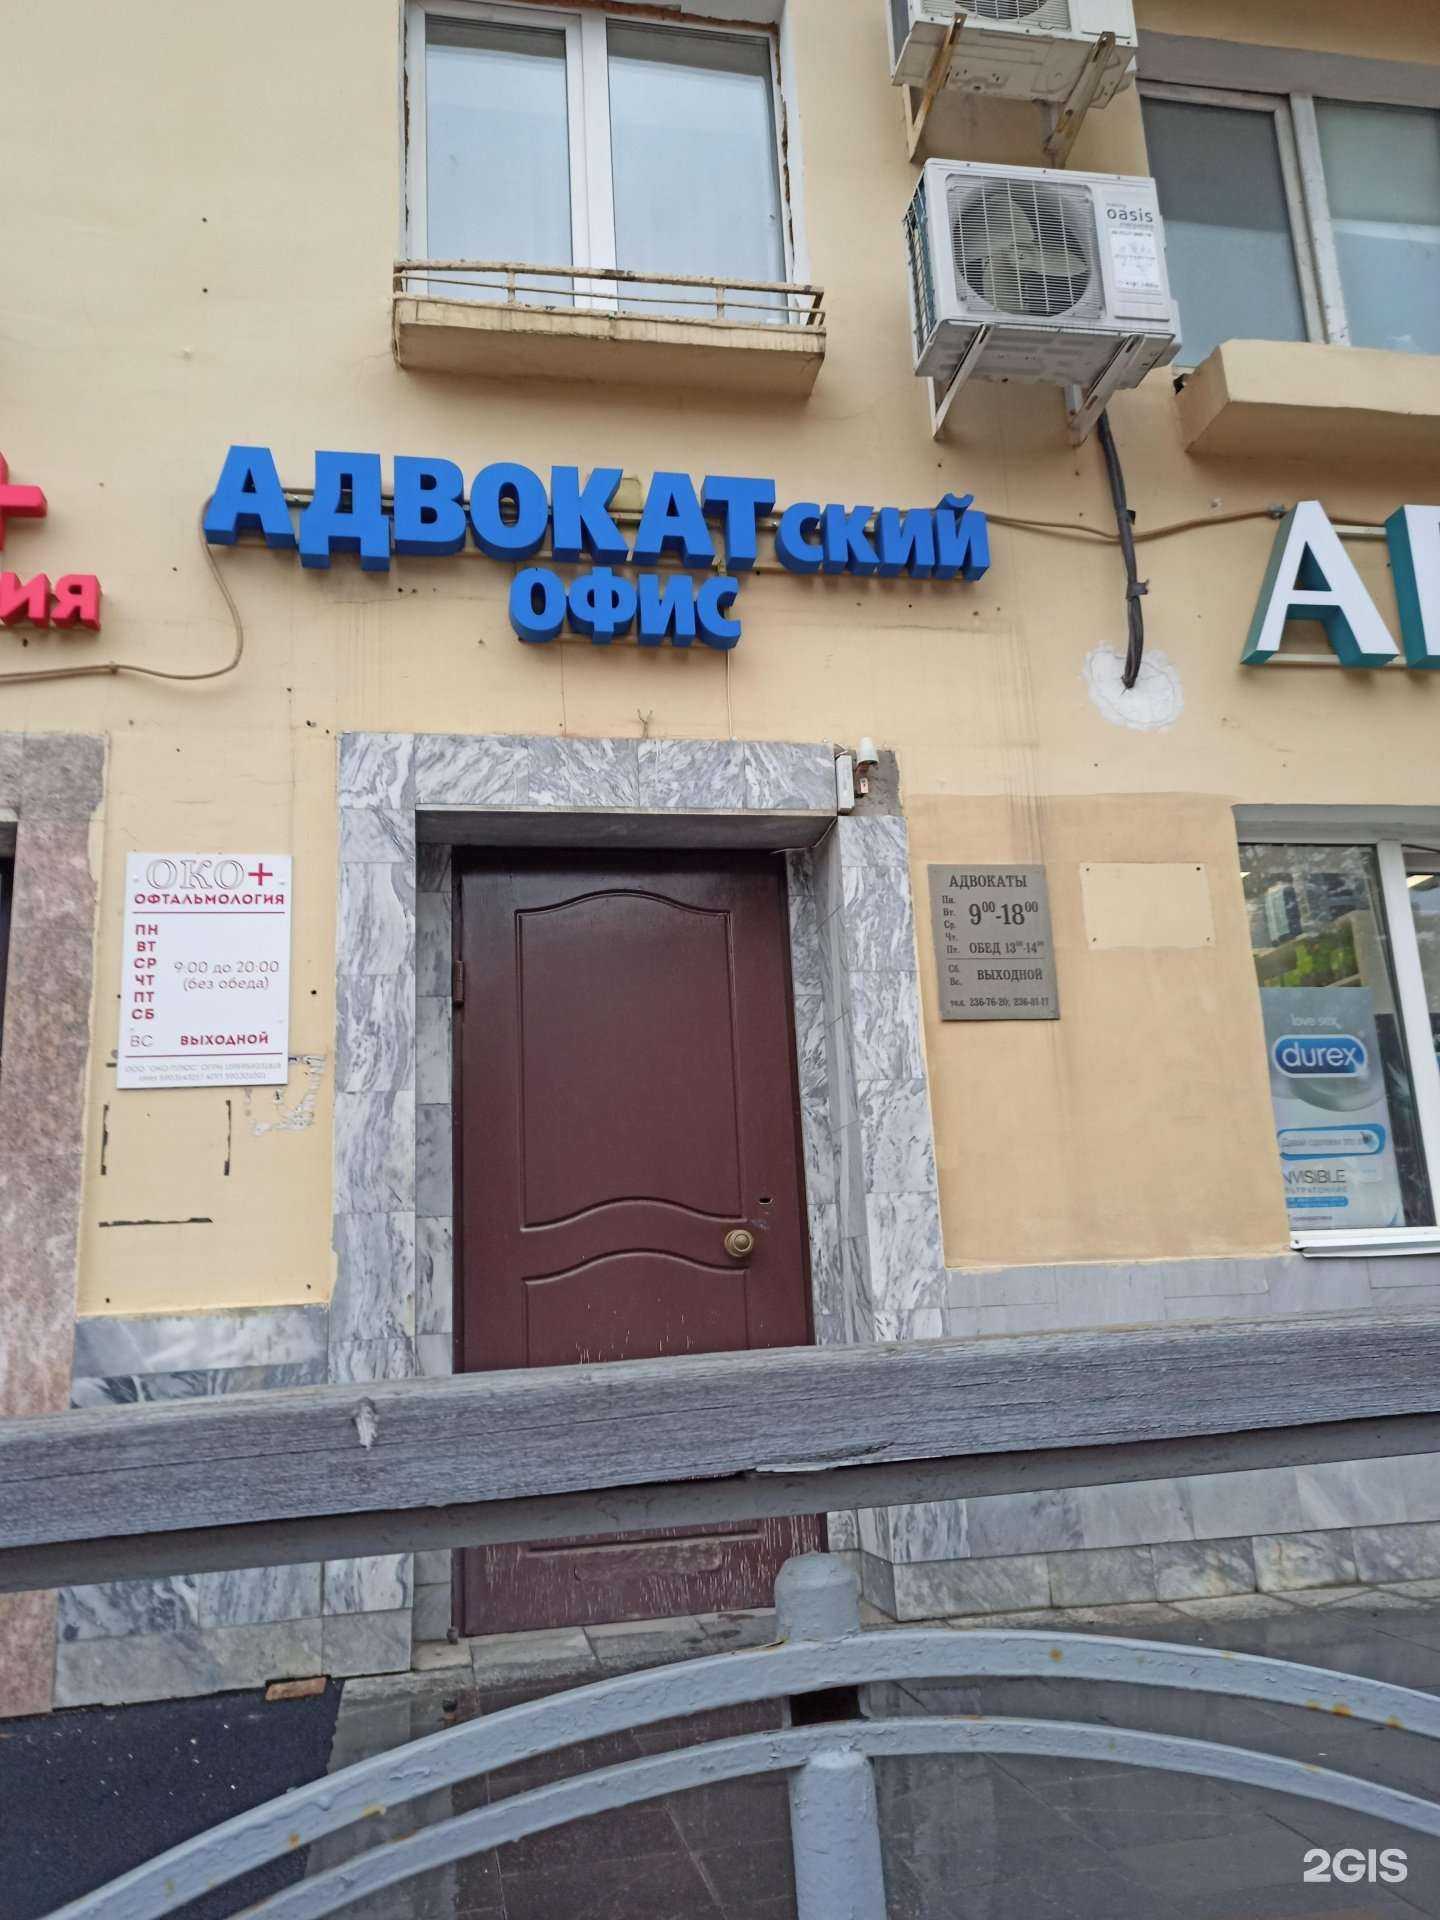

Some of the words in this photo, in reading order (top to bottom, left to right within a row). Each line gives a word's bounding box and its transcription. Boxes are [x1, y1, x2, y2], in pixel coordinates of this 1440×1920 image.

[1106, 208, 1153, 222] oasis
[948, 874, 1028, 889] АДВОКАТЫ
[133, 893, 285, 906] ОФТАЛЬМОЛОГИЯ
[135, 924, 160, 936] ПН
[136, 941, 156, 952] ВТ
[969, 942, 1001, 955] ОБЕД
[133, 957, 157, 969] СР
[212, 962, 231, 975] до
[135, 974, 155, 986] ЧТ
[977, 968, 1043, 983] ВЫХОДНОЙ
[183, 977, 214, 992] (без
[218, 976, 270, 991] обеда)
[133, 991, 155, 1003] ПТ
[131, 1008, 155, 1020] СБ
[129, 1034, 153, 1047] ВС
[180, 1031, 269, 1046] ВЫХОДНОЙ
[1281, 1041, 1357, 1067] durex
